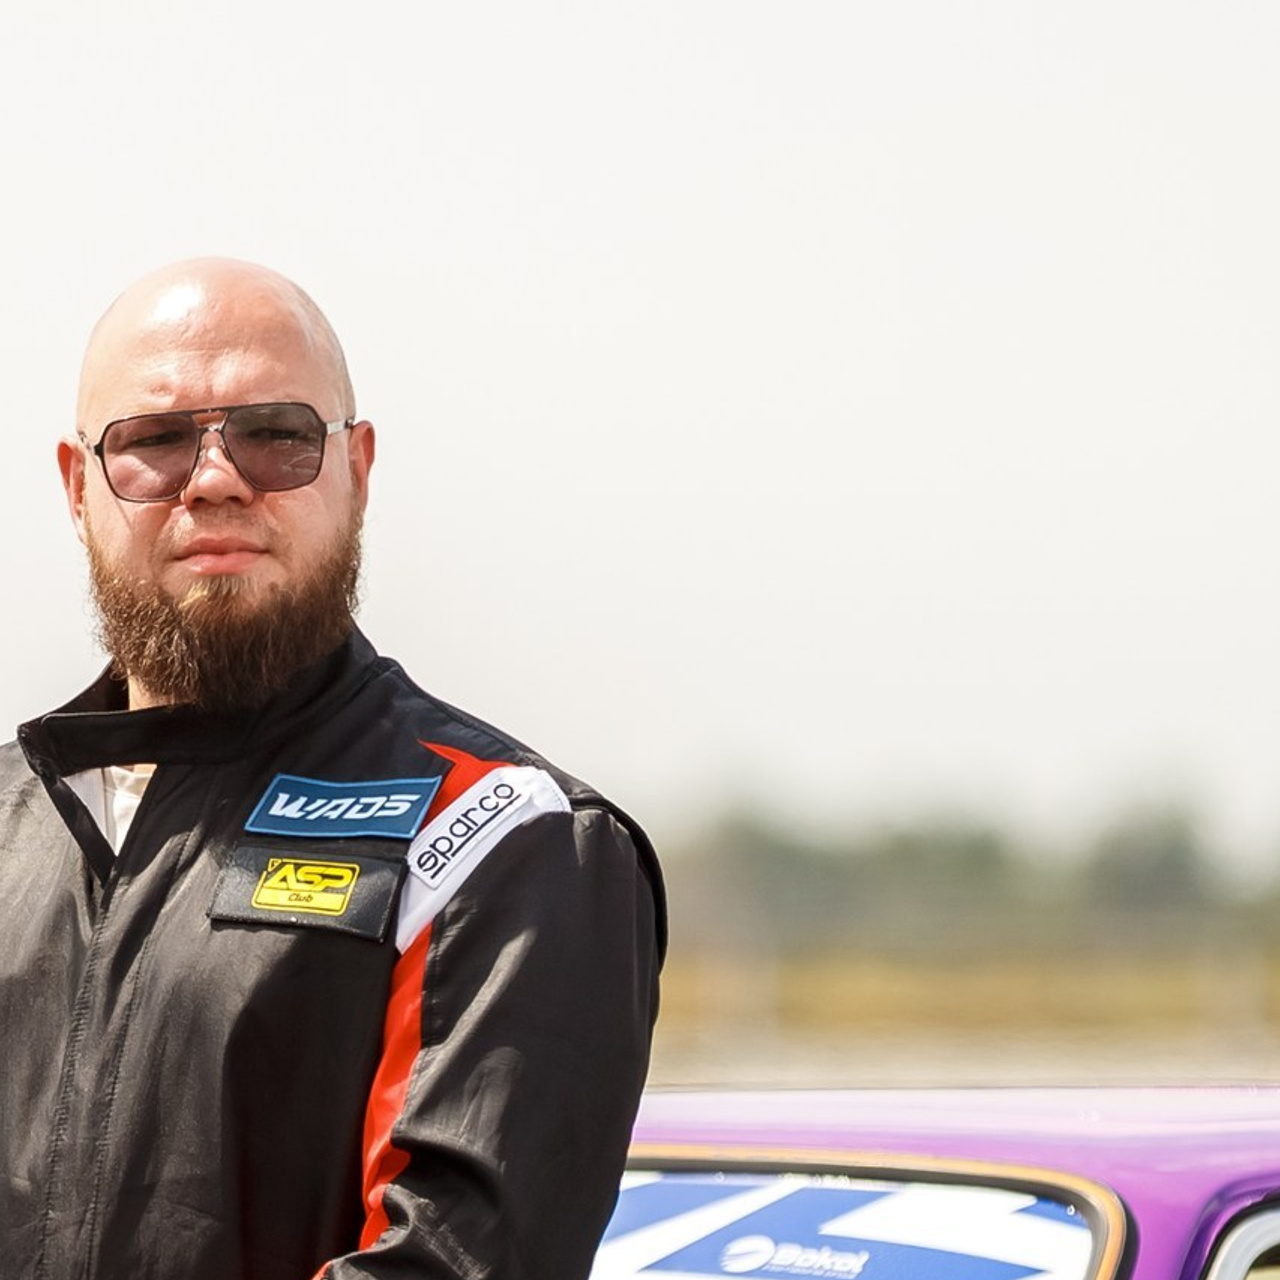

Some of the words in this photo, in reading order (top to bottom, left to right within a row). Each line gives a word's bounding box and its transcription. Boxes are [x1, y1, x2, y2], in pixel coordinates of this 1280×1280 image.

[269, 793, 421, 820] WADS
[417, 783, 516, 876] sparco
[263, 864, 353, 891] ASP
[288, 893, 314, 903] Club
